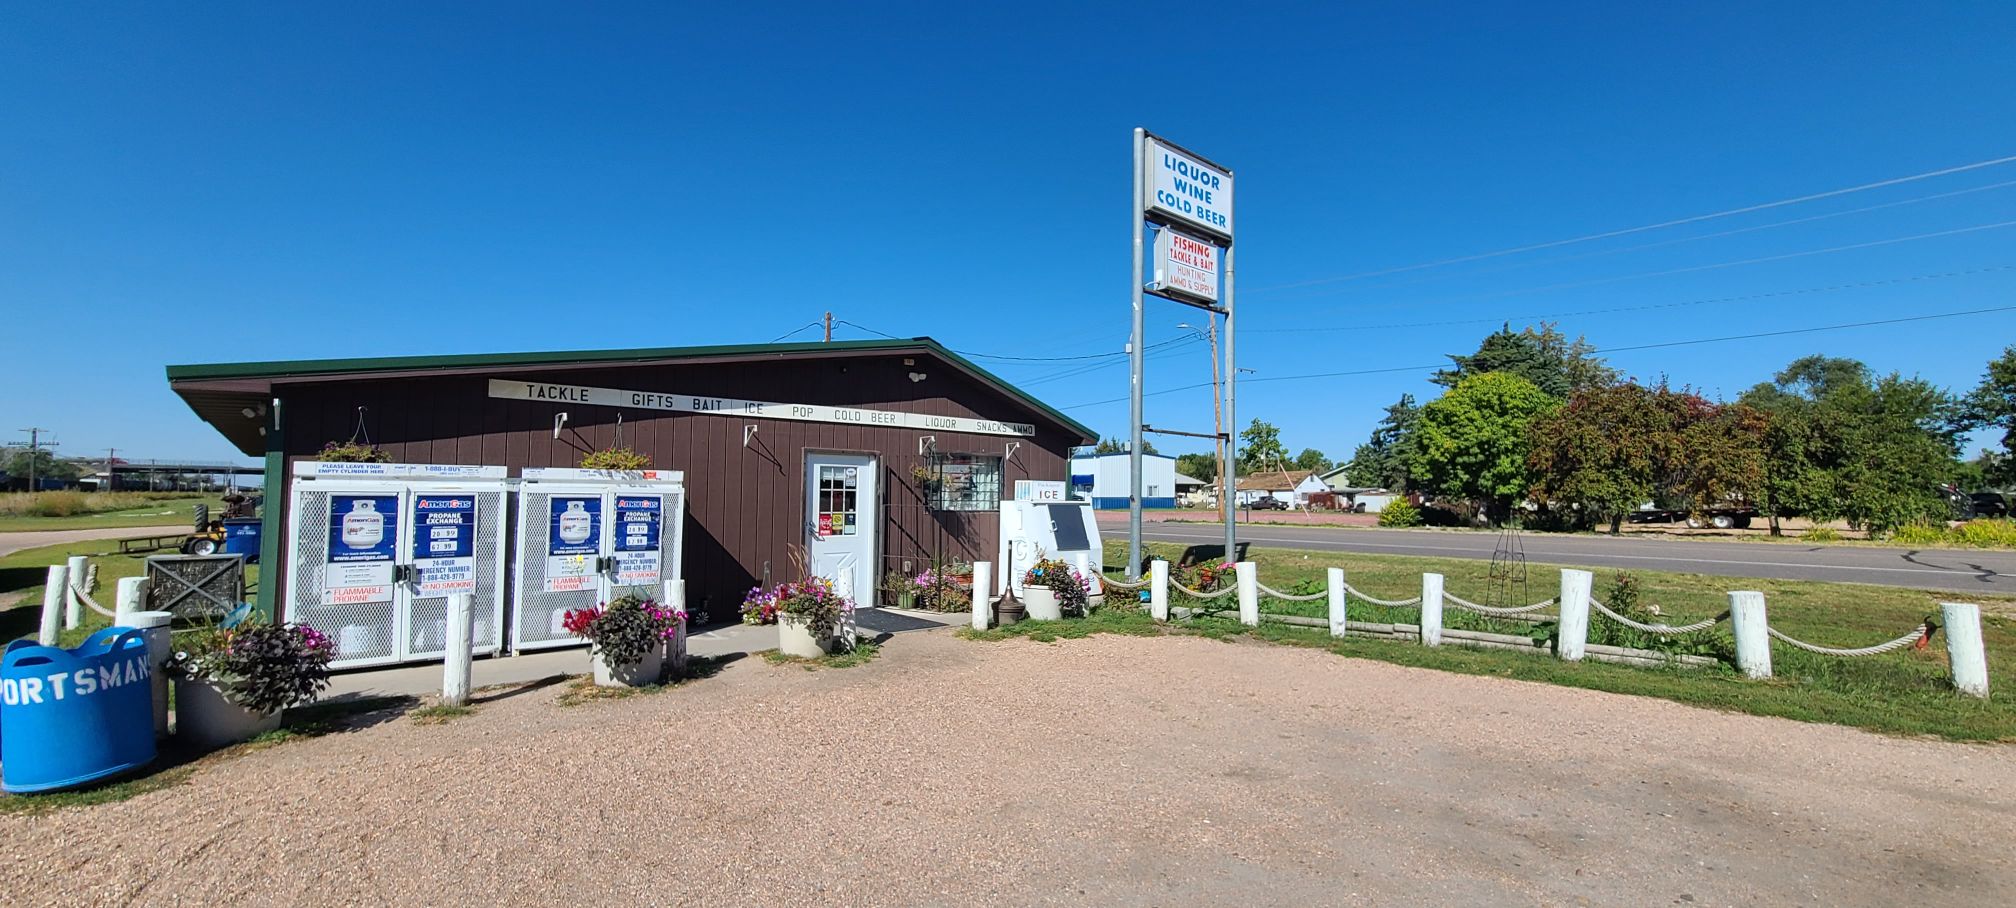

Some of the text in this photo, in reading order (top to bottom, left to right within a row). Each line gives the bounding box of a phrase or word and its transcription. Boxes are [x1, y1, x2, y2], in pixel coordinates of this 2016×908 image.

[1164, 154, 1220, 191] LIQUOR
[1173, 177, 1212, 205] WINE
[1157, 190, 1226, 228] COLD BEER
[1173, 236, 1210, 259] FISHING
[1170, 248, 1213, 271] TACKLE & BAIT
[1177, 265, 1206, 282] HUNTING
[1170, 275, 1187, 288] AMMO
[1193, 281, 1215, 296] SUPPLY
[526, 384, 1033, 435] TACKLE GIFTS BAIT ICE POP COLD BEER LIQUOR SNACKS AMMO
[418, 499, 472, 509] AmeriGas
[1039, 490, 1058, 499] ICE
[432, 559, 455, 567] 24-HOUR
[333, 586, 384, 595] FLAMMABLE
[441, 581, 474, 589] SMOKING
[333, 594, 369, 603] PROPANE
